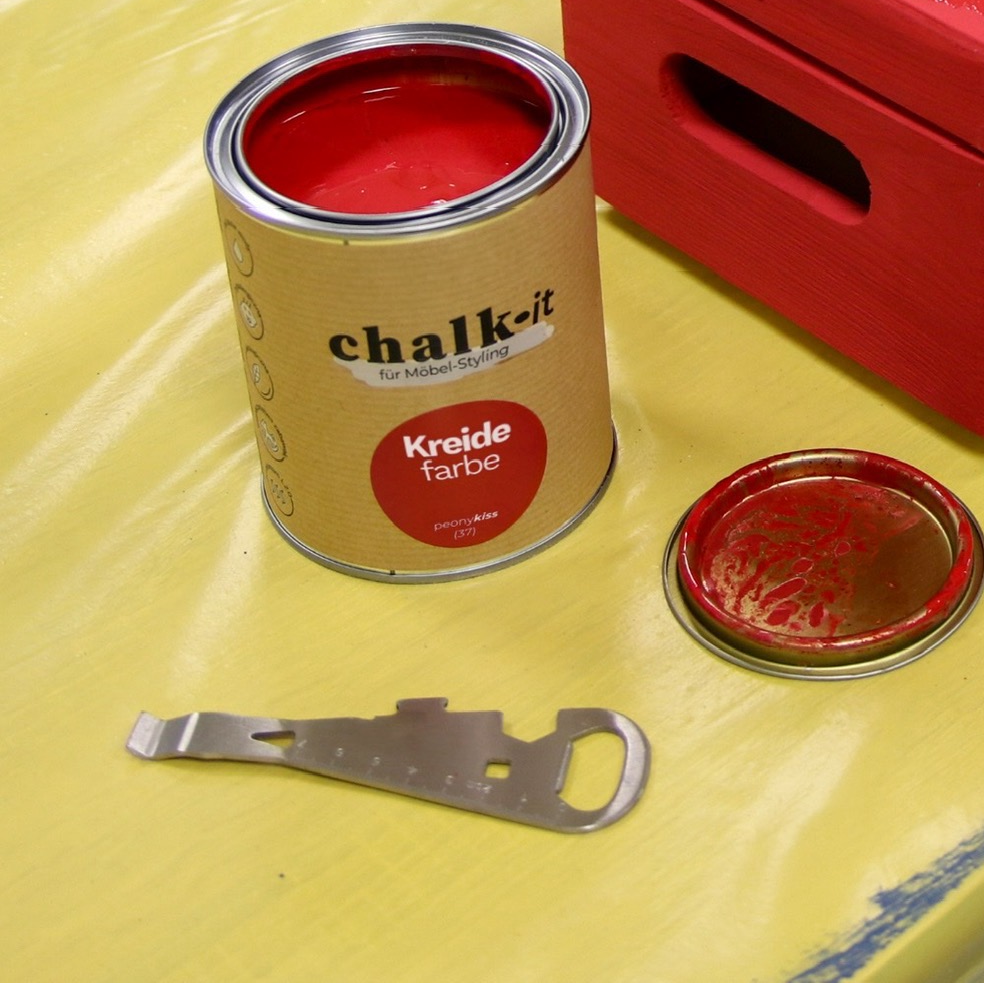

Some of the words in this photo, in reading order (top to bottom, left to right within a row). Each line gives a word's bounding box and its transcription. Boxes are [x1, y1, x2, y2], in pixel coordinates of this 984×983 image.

[378, 369, 401, 381] für
[405, 345, 511, 378] Möbel-Styling
[402, 420, 512, 459] Kreide
[420, 453, 501, 482] farbe
[434, 511, 500, 532] peonykiss
[453, 526, 477, 540] (37)
